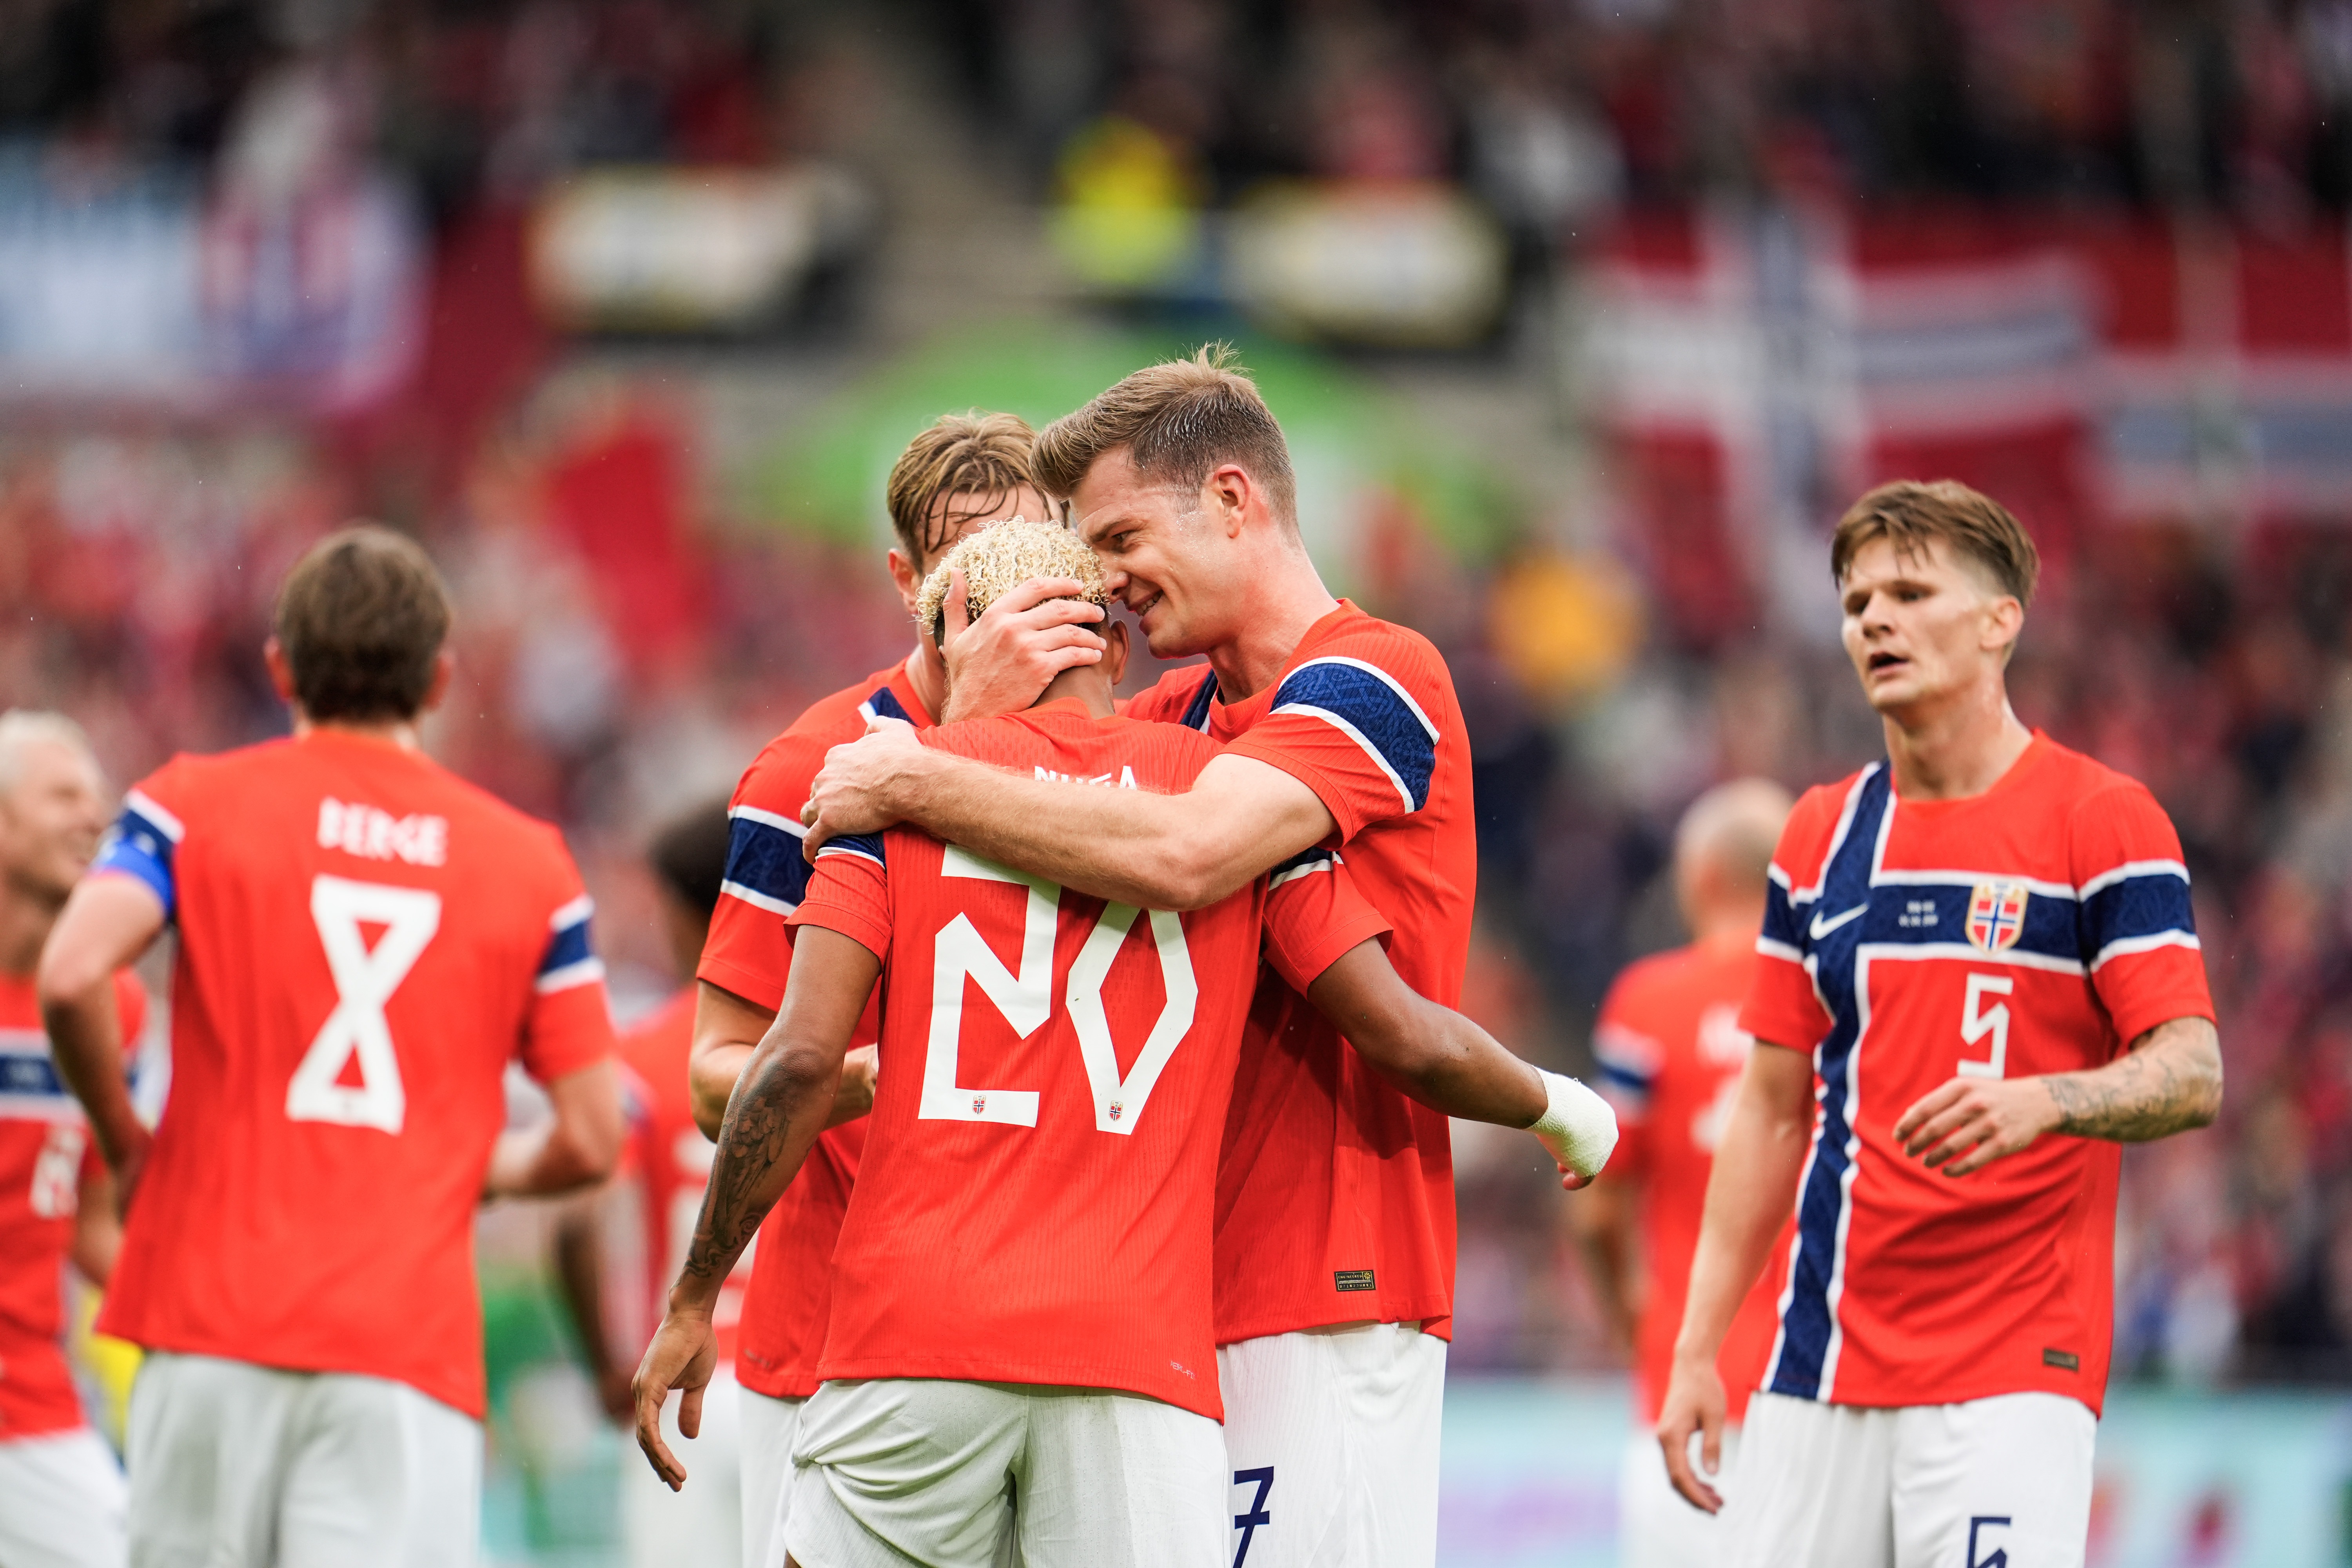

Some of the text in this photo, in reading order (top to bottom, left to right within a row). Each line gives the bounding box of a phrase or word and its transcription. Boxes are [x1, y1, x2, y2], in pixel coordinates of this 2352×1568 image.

[317, 796, 449, 867] BERGE
[285, 873, 443, 1136] 8
[918, 842, 1198, 1136] 20
[1956, 972, 2014, 1081] 5
[1232, 1466, 1274, 1568] 7
